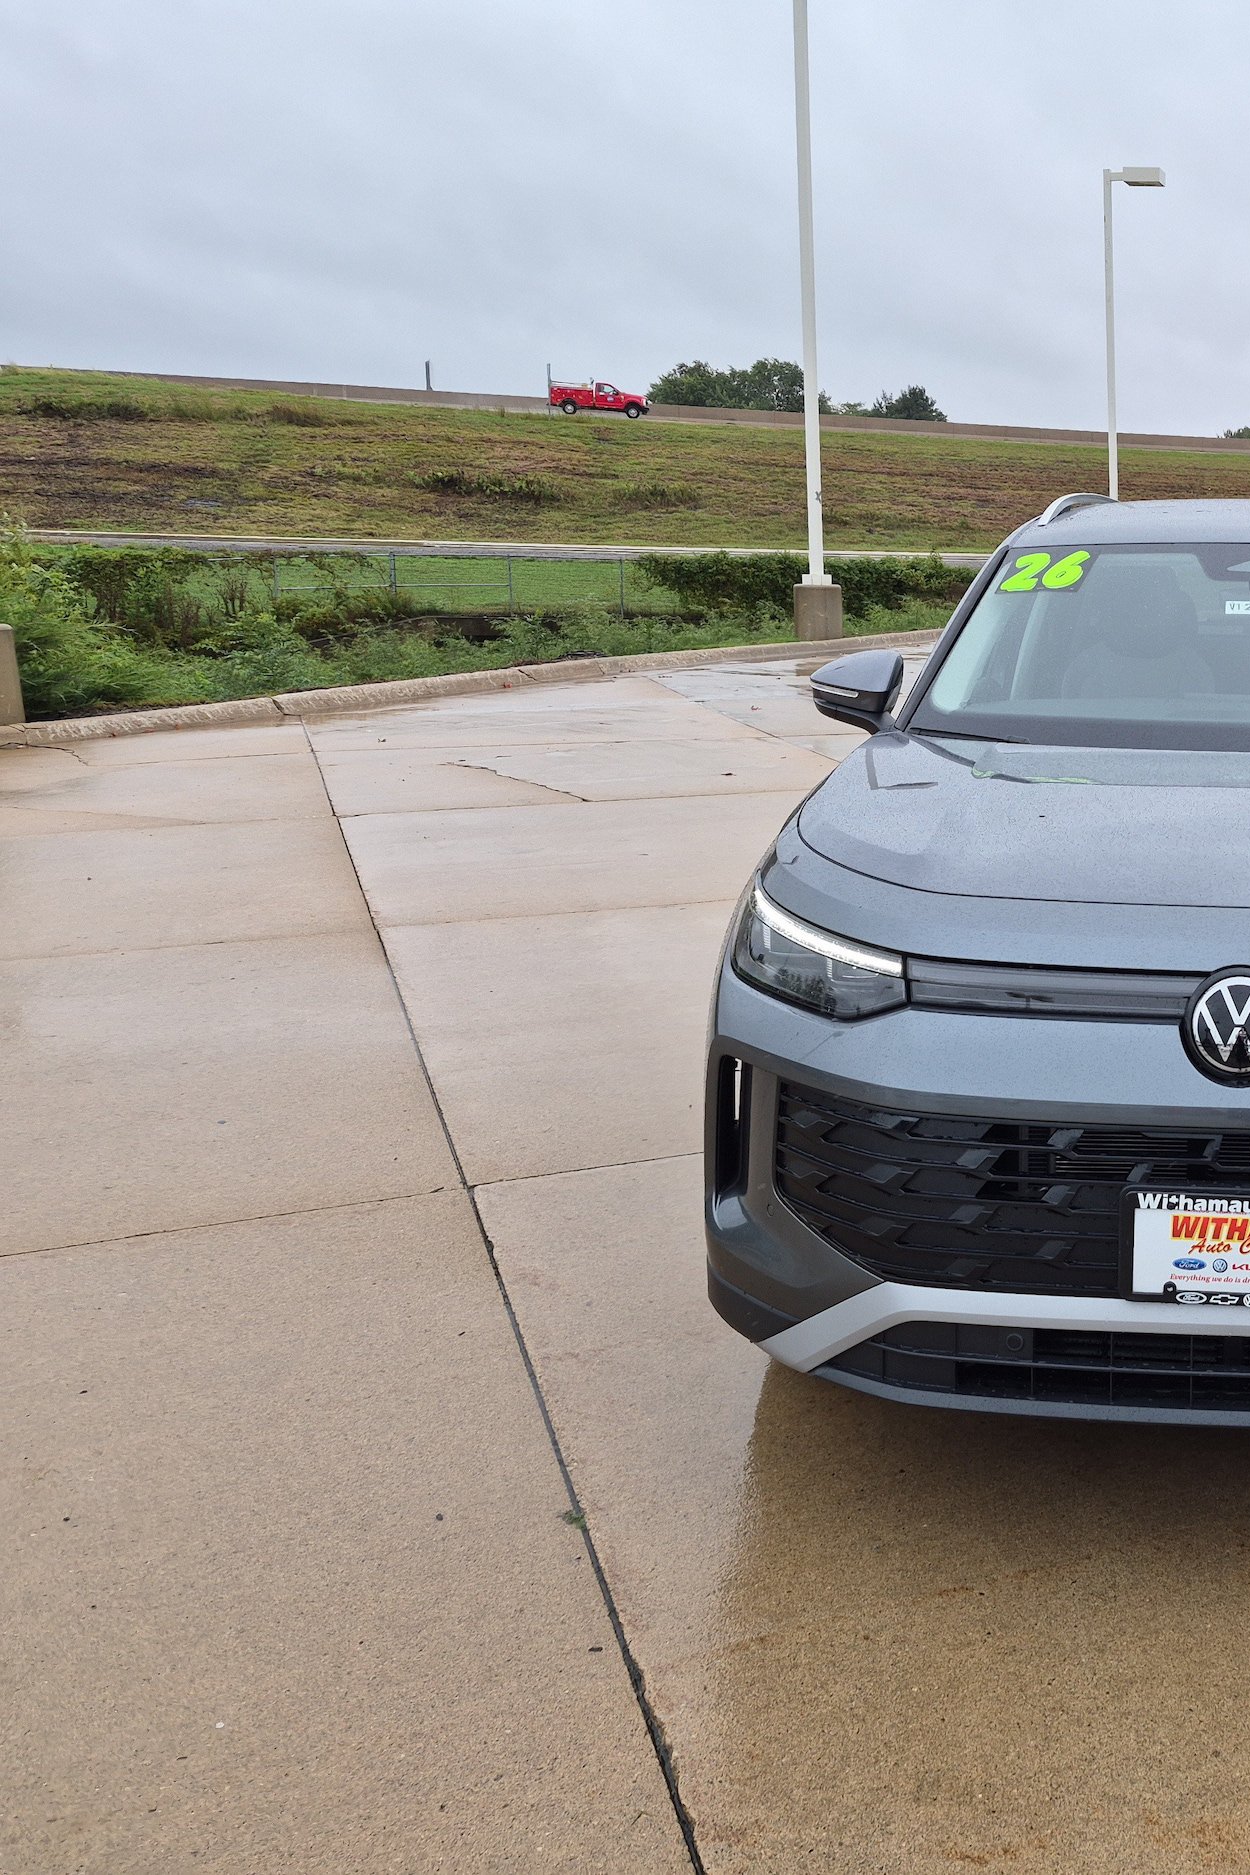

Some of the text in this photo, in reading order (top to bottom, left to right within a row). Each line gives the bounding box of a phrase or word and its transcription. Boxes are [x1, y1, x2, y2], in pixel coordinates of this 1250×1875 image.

[1000, 550, 1090, 592] 26
[1188, 1238, 1233, 1255] Auto
[1170, 1273, 1210, 1283] Everything
